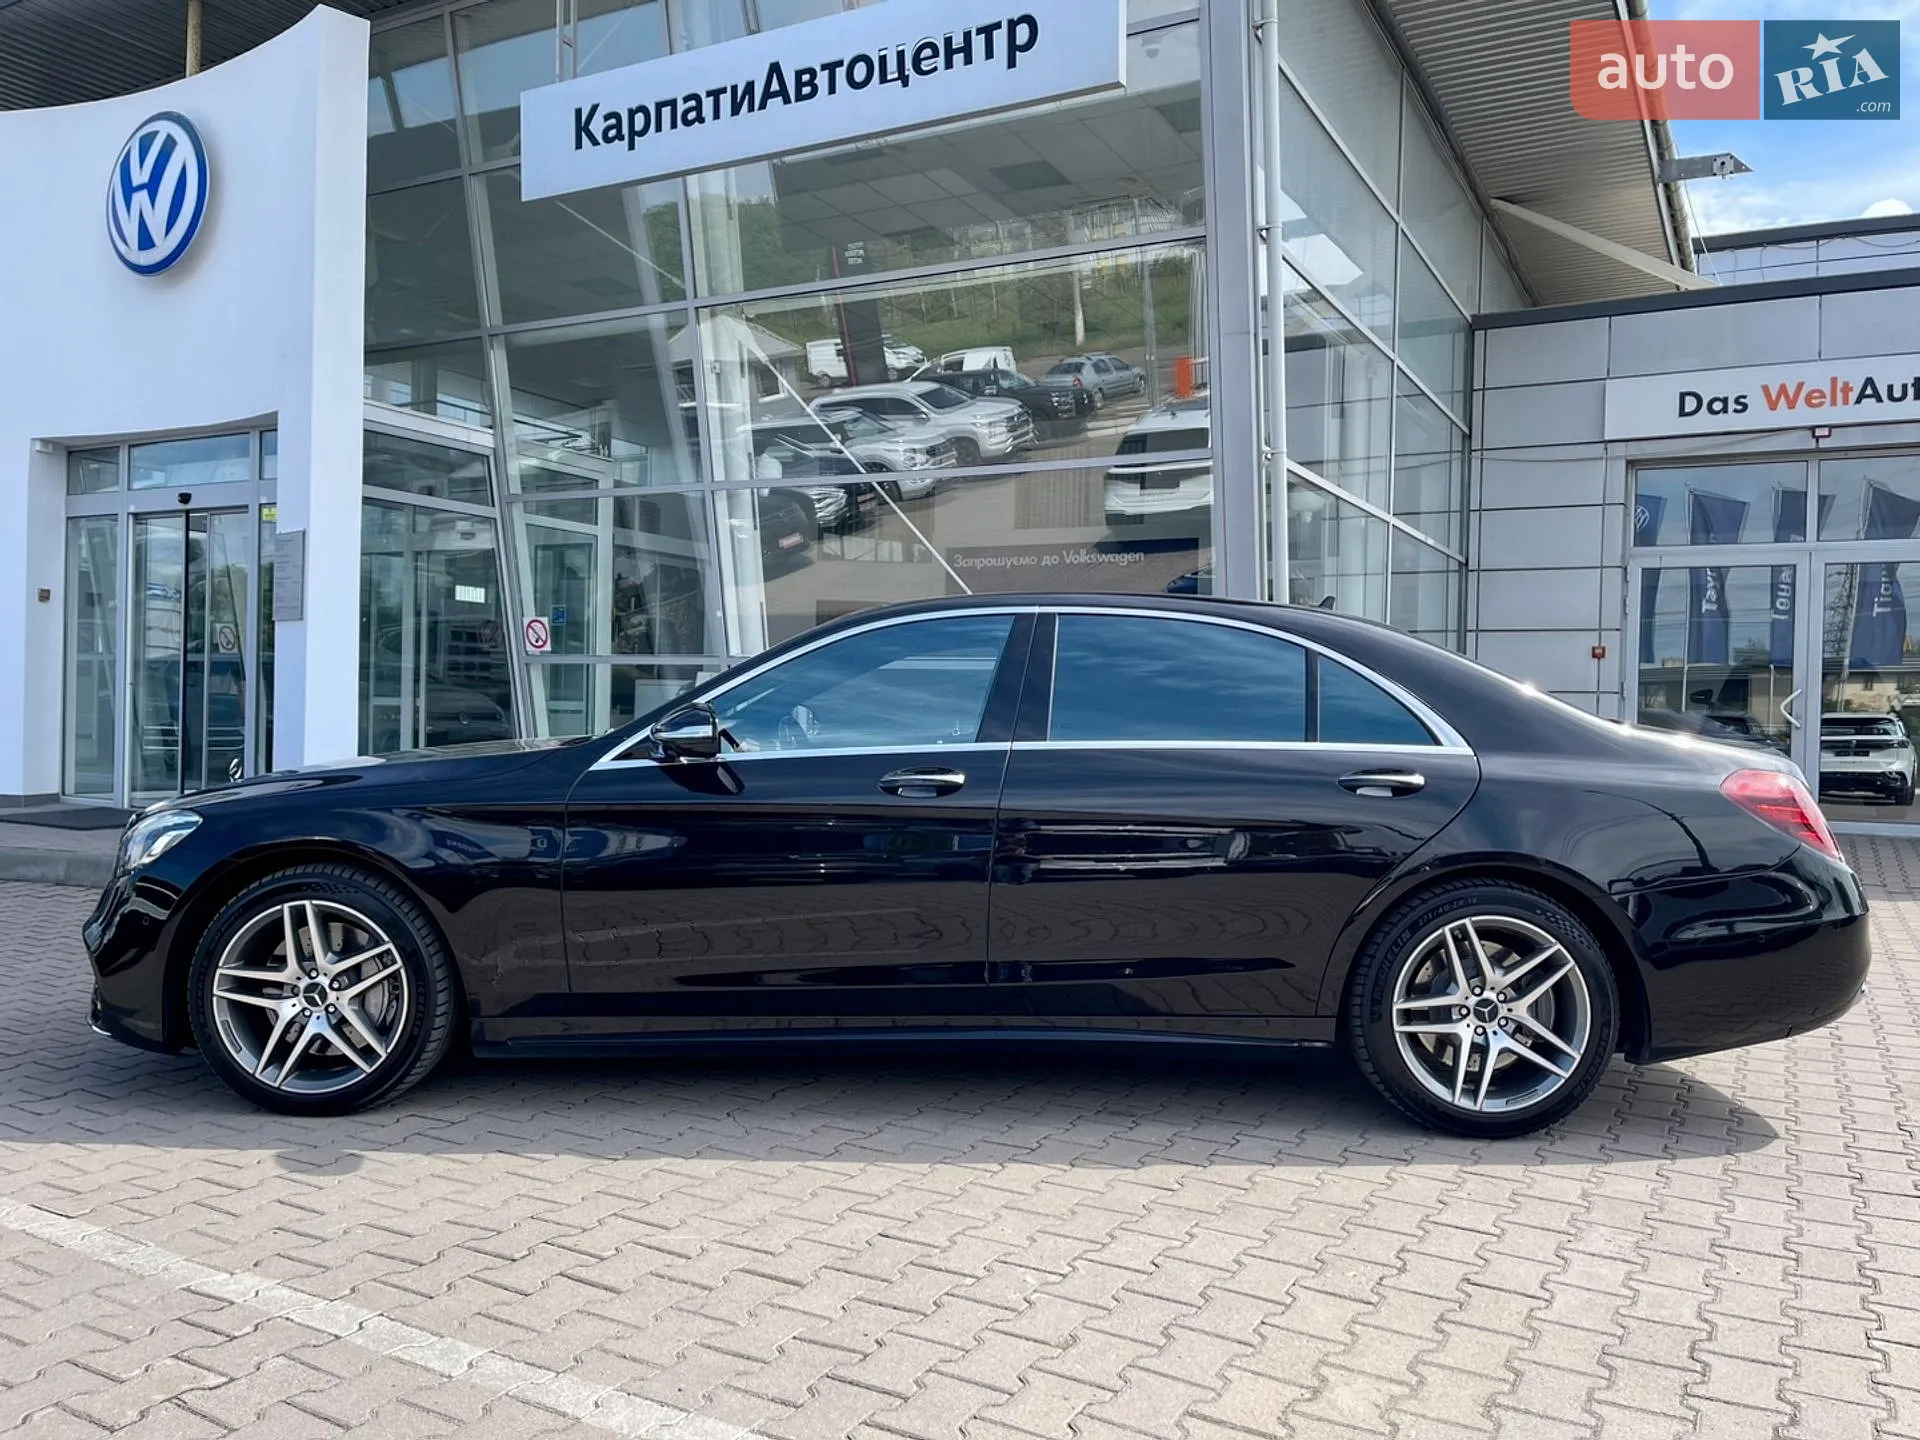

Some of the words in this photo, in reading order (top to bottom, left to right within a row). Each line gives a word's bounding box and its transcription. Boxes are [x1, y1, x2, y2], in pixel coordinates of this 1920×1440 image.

[573, 12, 1039, 152] КарпатиАвтоцентр
[1678, 390, 1749, 418] Das
[953, 554, 1037, 569] Запрошуємо
[1041, 555, 1060, 567] до
[1062, 549, 1145, 566] Volkswagen
